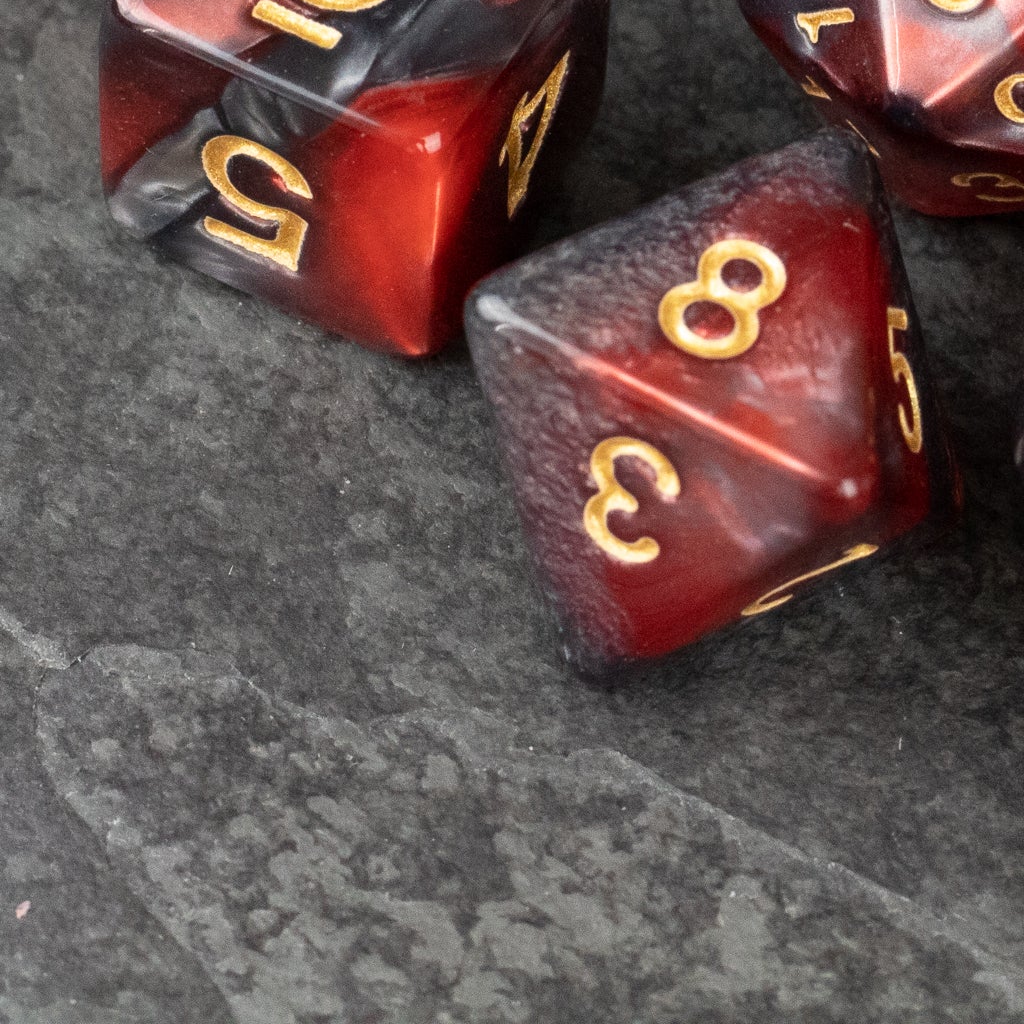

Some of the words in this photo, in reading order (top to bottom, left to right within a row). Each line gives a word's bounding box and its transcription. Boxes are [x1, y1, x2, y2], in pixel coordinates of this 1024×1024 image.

[499, 51, 569, 216] 4
[201, 135, 312, 269] 5
[658, 238, 786, 358] 8
[887, 307, 922, 452] 5
[583, 436, 680, 562] 3
